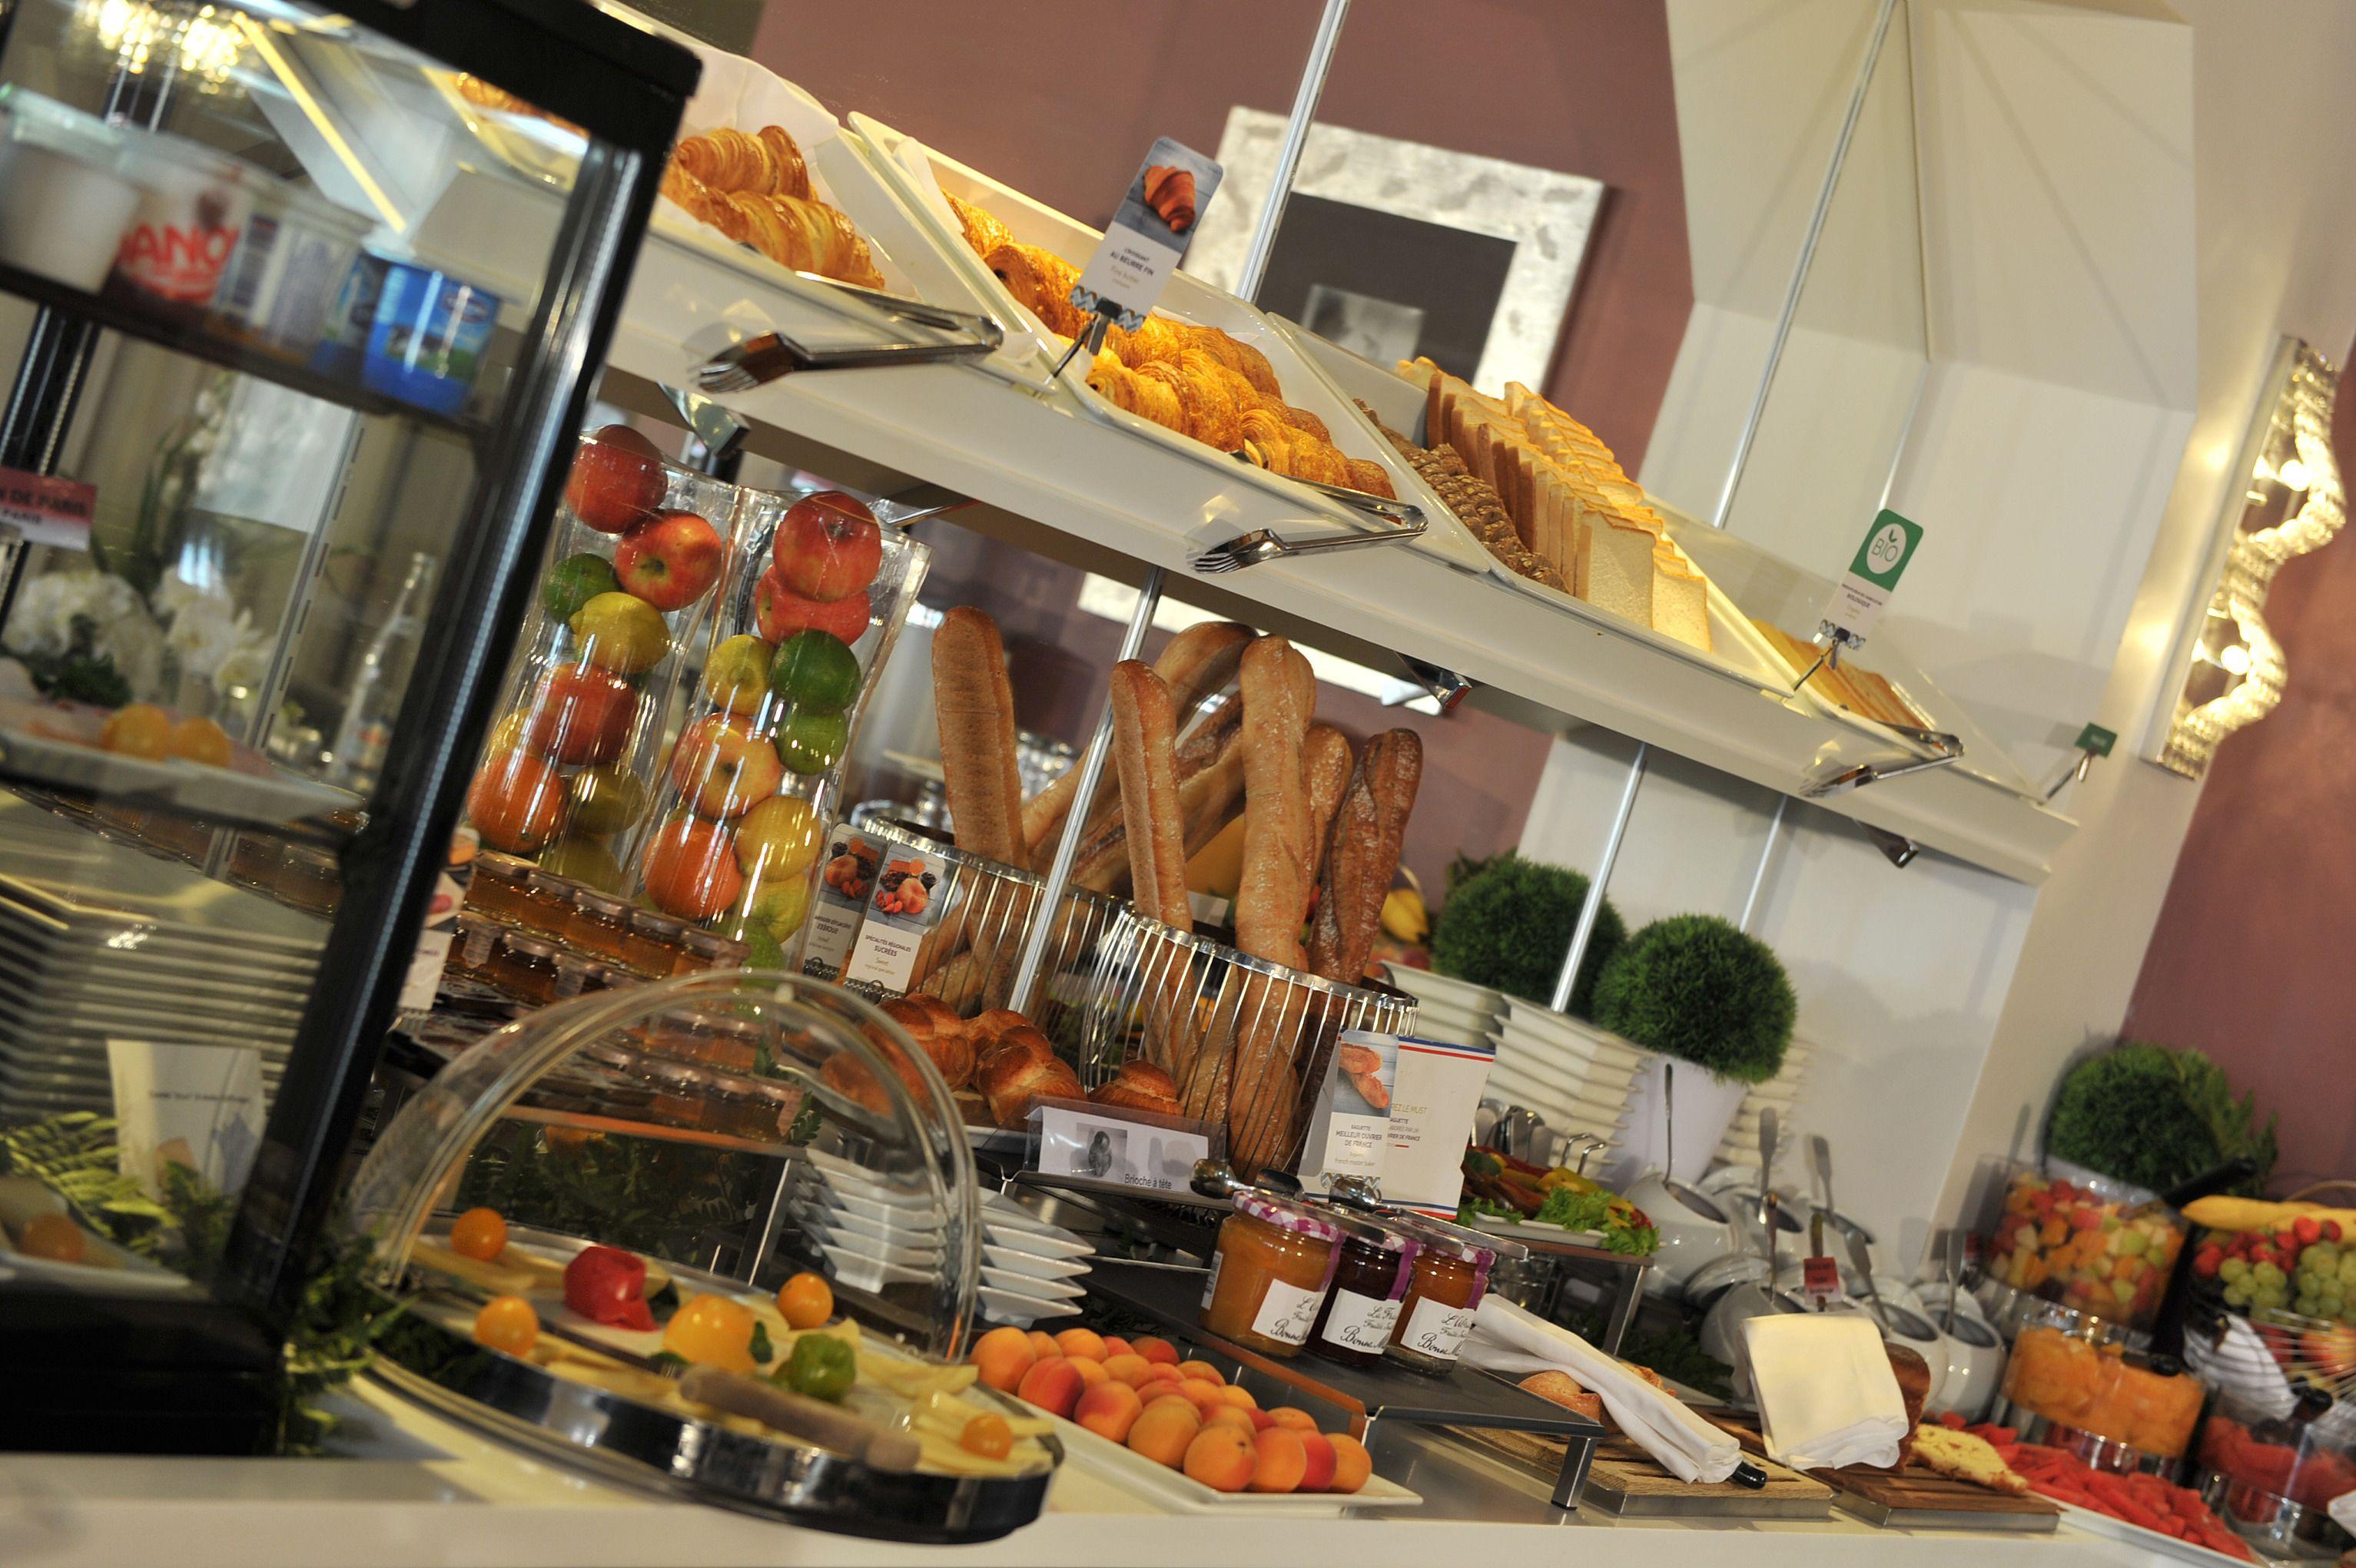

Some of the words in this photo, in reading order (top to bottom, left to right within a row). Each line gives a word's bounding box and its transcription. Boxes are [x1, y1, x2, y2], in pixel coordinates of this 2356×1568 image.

[1120, 254, 1143, 271] BEURRE
[1143, 266, 1155, 277] FIN
[1871, 538, 1898, 562] BIO
[865, 934, 888, 946] SPÉCIALITÉS
[888, 940, 912, 953] RÉGIONALES
[874, 945, 898, 957] SUCRÉES
[1336, 1130, 1361, 1139] MEILLEUR
[1125, 1173, 1151, 1187] Brioche
[1153, 1178, 1157, 1188] à
[1159, 1178, 1172, 1189] tête
[1270, 1318, 1300, 1341] Bonne
[1339, 1325, 1374, 1348] Bonne
[1417, 1332, 1451, 1355] Bonne
